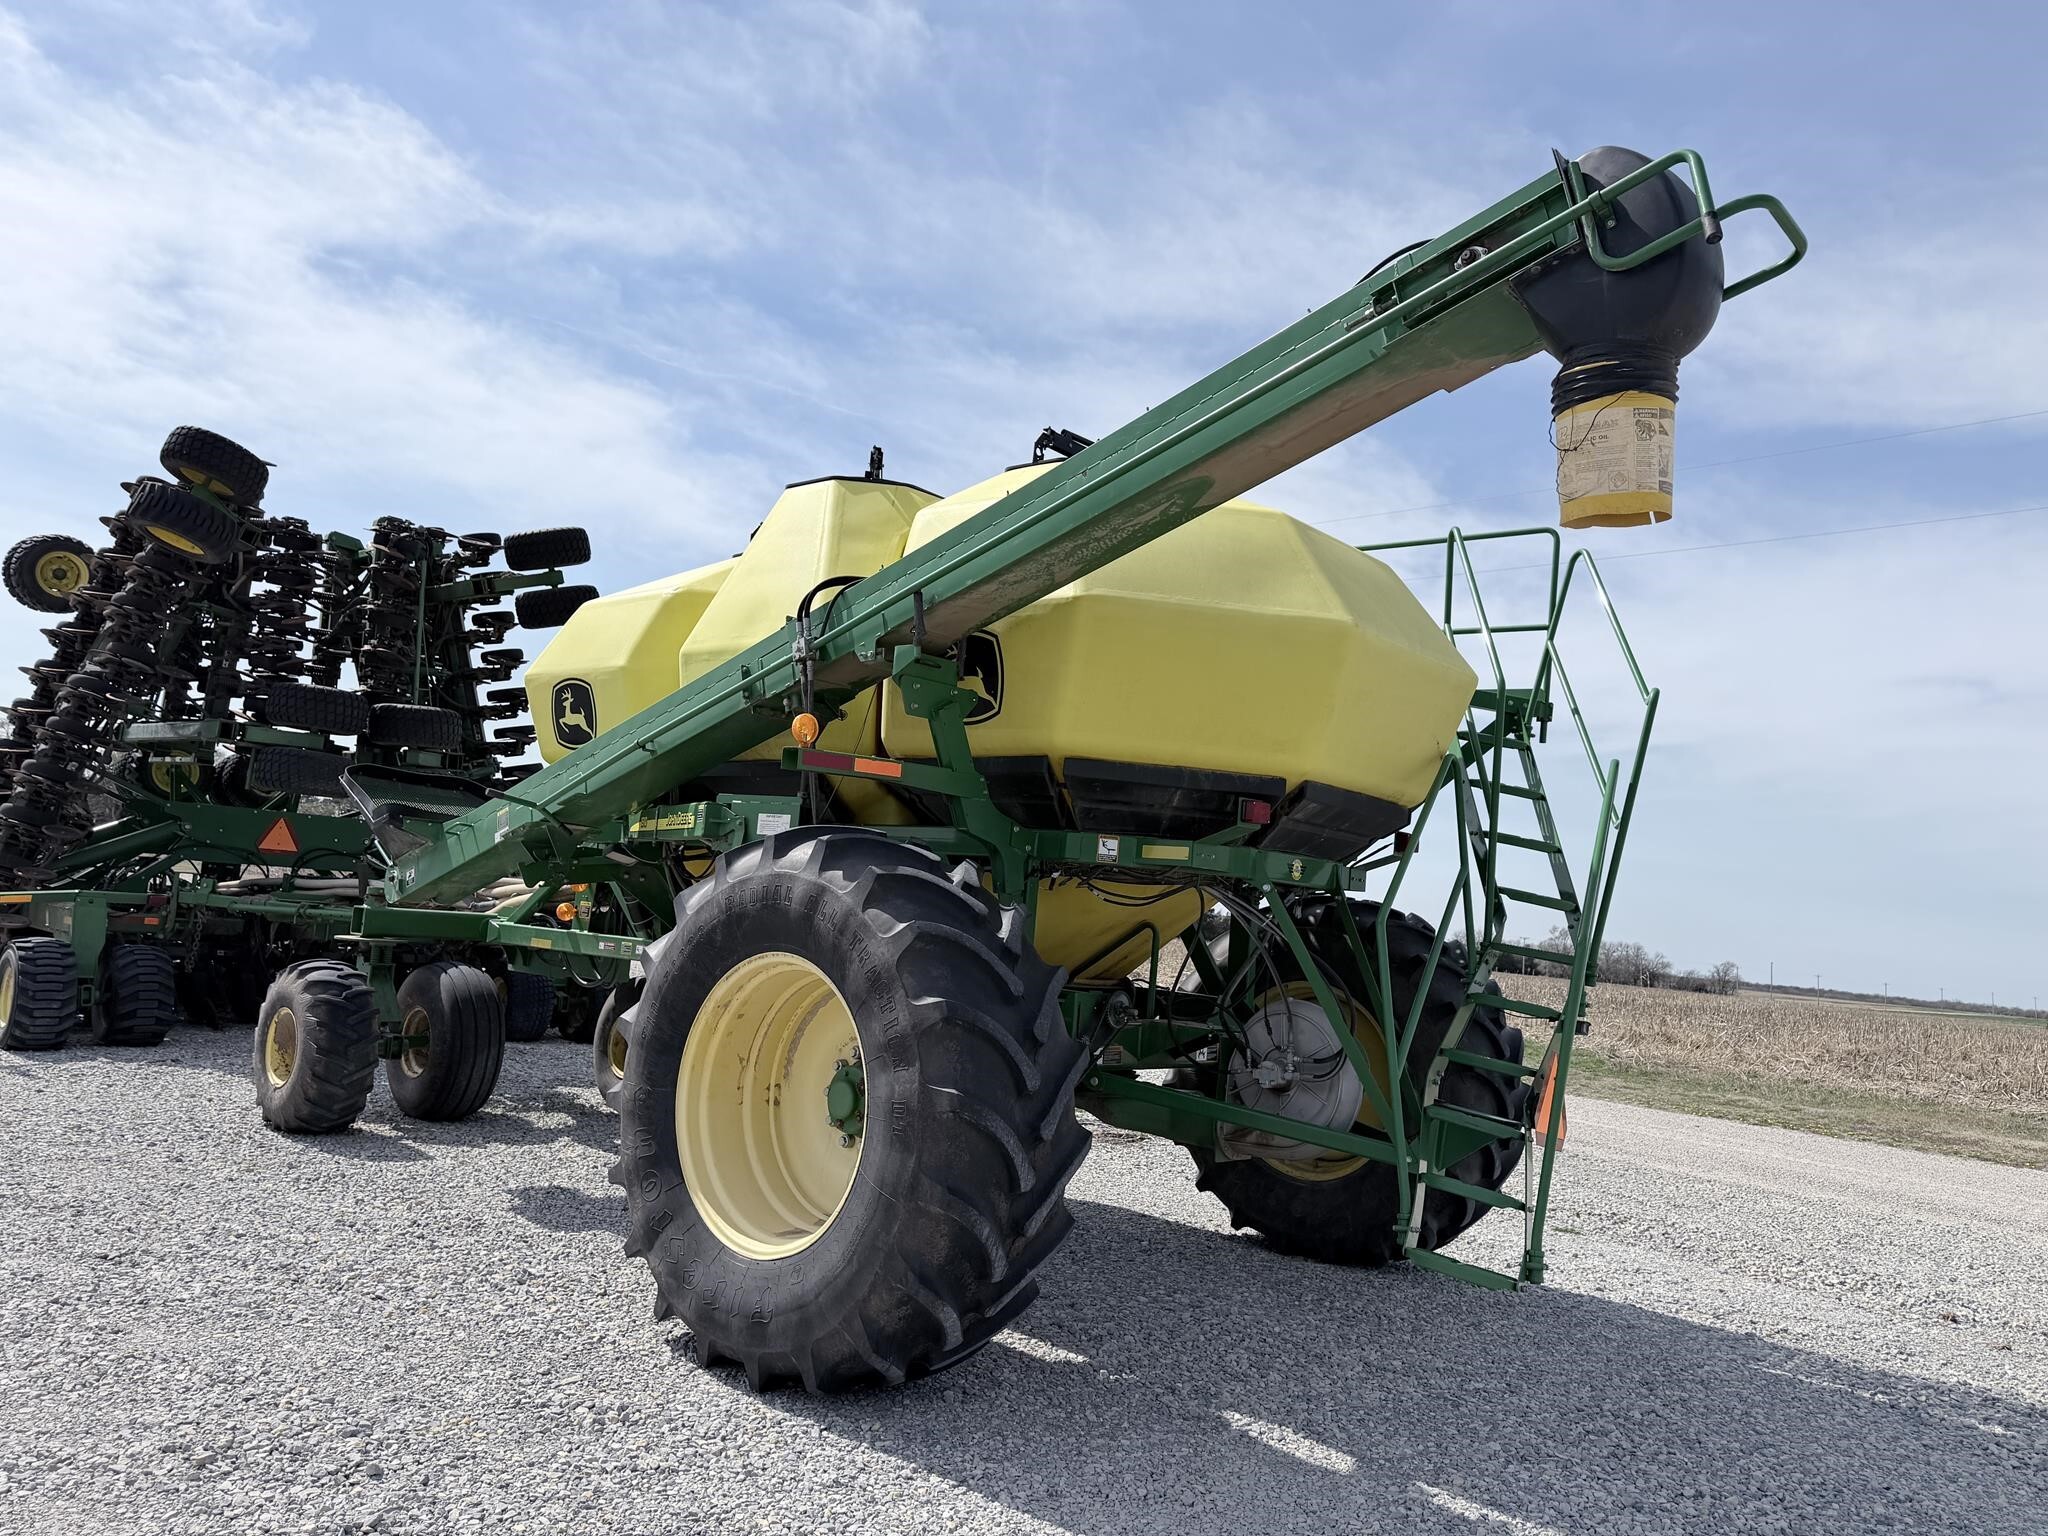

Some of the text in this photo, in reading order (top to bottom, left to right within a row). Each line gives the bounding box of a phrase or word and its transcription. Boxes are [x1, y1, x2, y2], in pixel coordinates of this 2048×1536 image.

[666, 812, 678, 827] JOHN
[678, 811, 692, 826] DEERE
[725, 884, 794, 915] RADIAL
[804, 893, 840, 932] ALL
[846, 929, 909, 1073] TRACTION
[633, 1085, 774, 1324] Firestone
